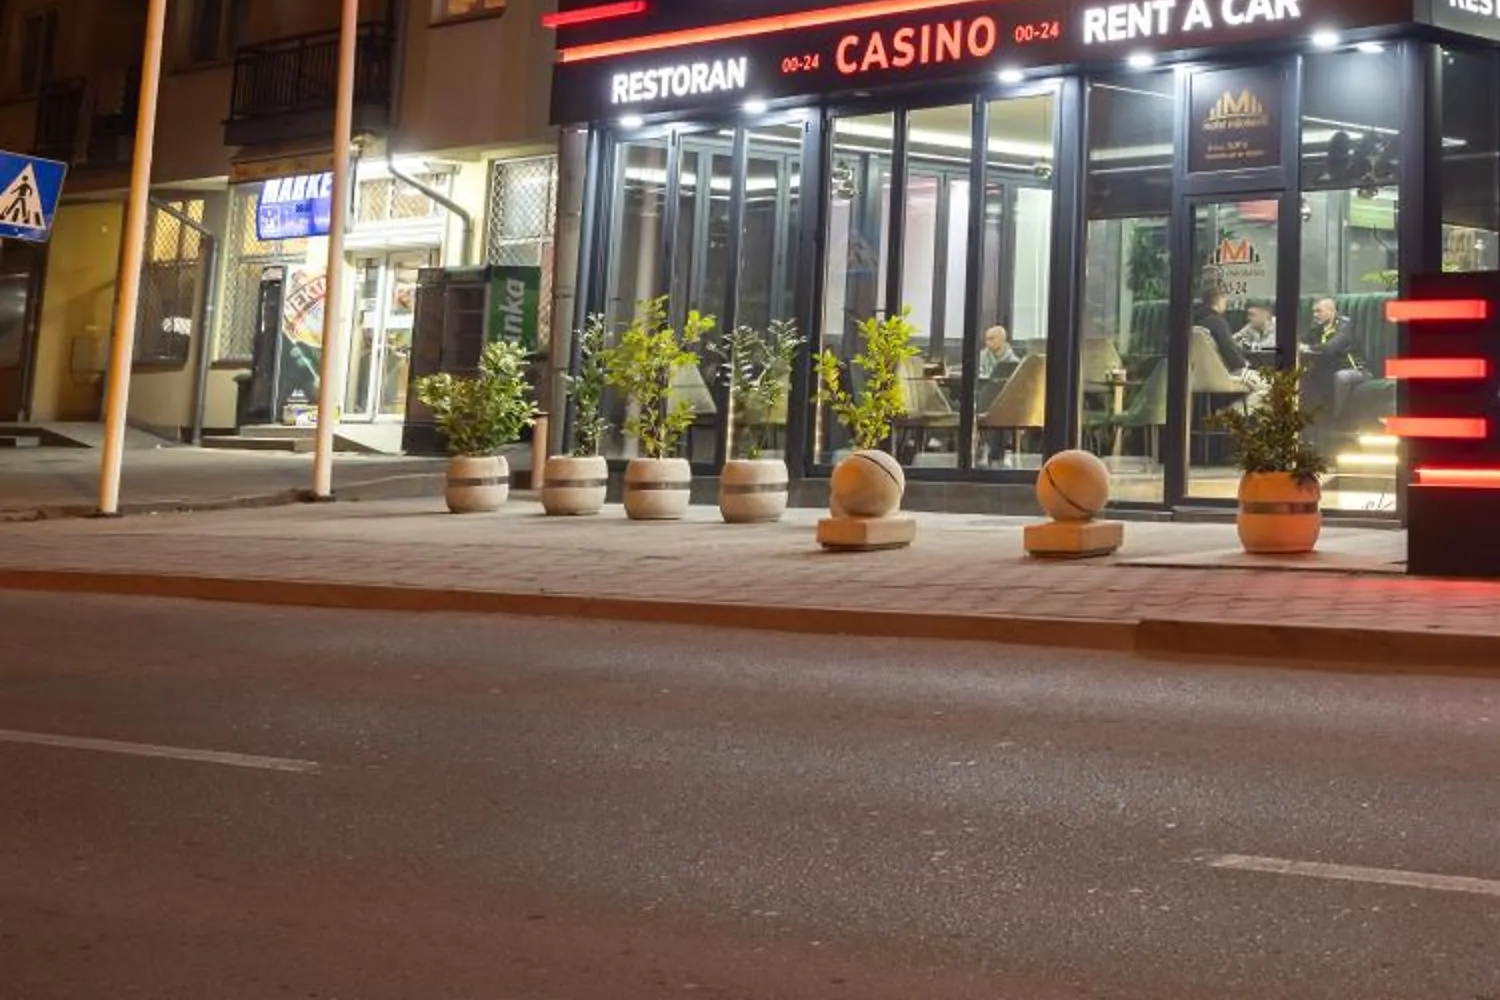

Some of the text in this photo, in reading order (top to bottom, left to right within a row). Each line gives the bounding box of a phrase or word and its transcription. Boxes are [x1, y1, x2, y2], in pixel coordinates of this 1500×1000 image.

[611, 57, 748, 104] RESTORAN
[781, 53, 820, 74] 00-24
[835, 15, 997, 76] CASINO
[1014, 21, 1060, 43] 00-24
[261, 171, 334, 204] MARKE
[498, 280, 525, 343] inka
